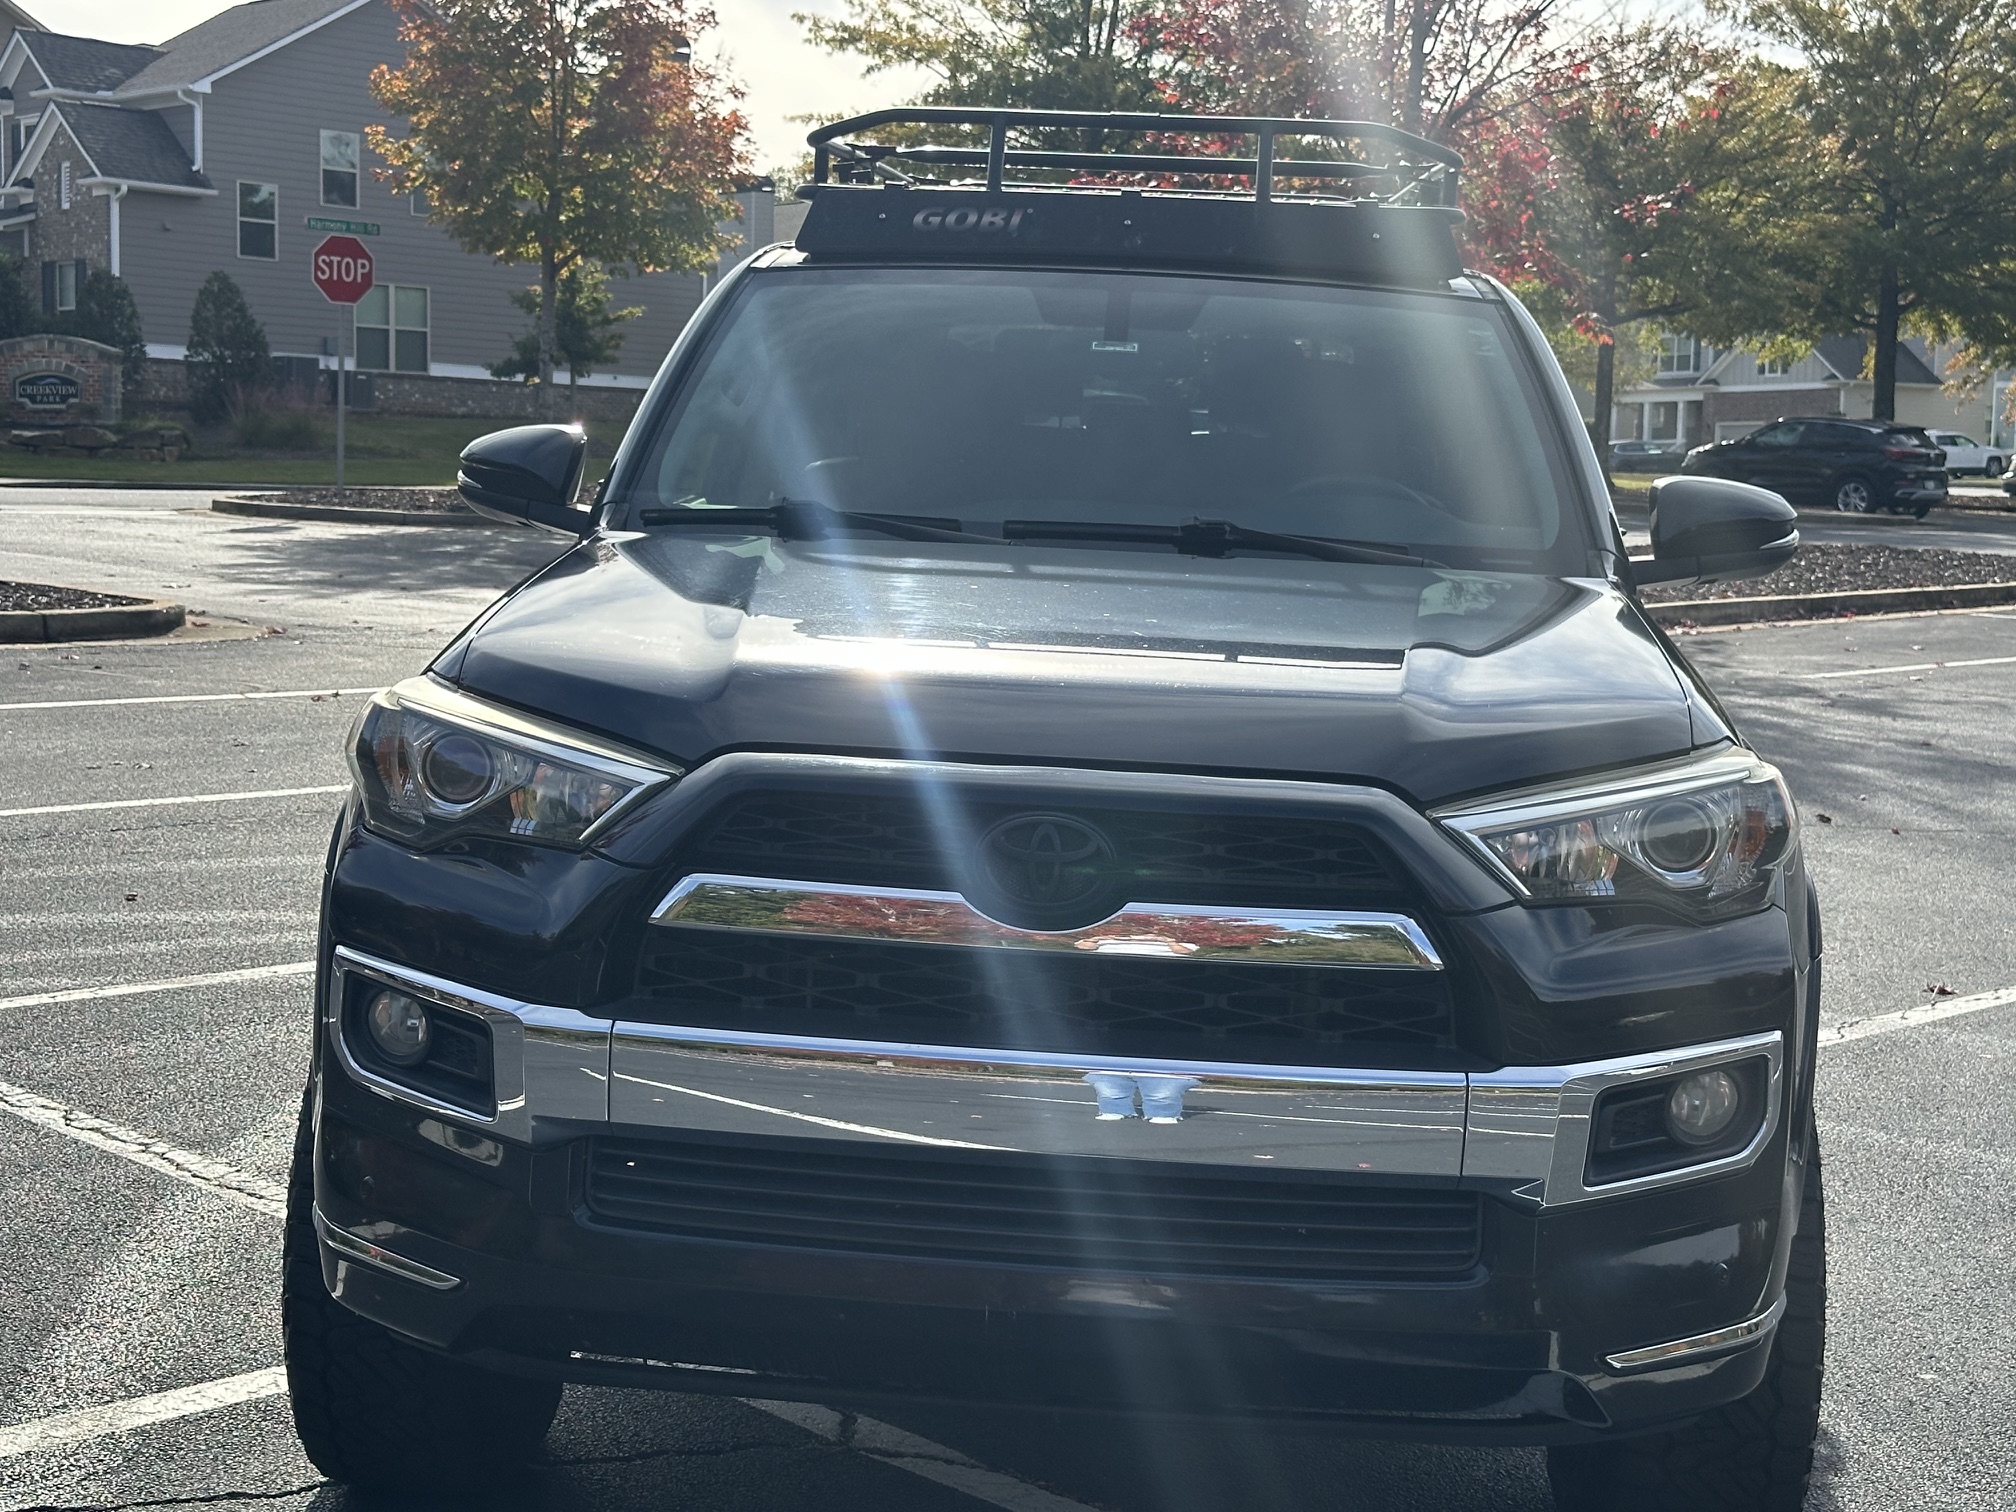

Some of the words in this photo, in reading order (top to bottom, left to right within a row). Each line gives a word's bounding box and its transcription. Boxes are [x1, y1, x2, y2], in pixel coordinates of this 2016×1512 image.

[310, 218, 348, 232] Harmony
[912, 206, 1024, 233] GOBI
[317, 255, 370, 283] STOP
[20, 385, 77, 395] CREEKVIEW
